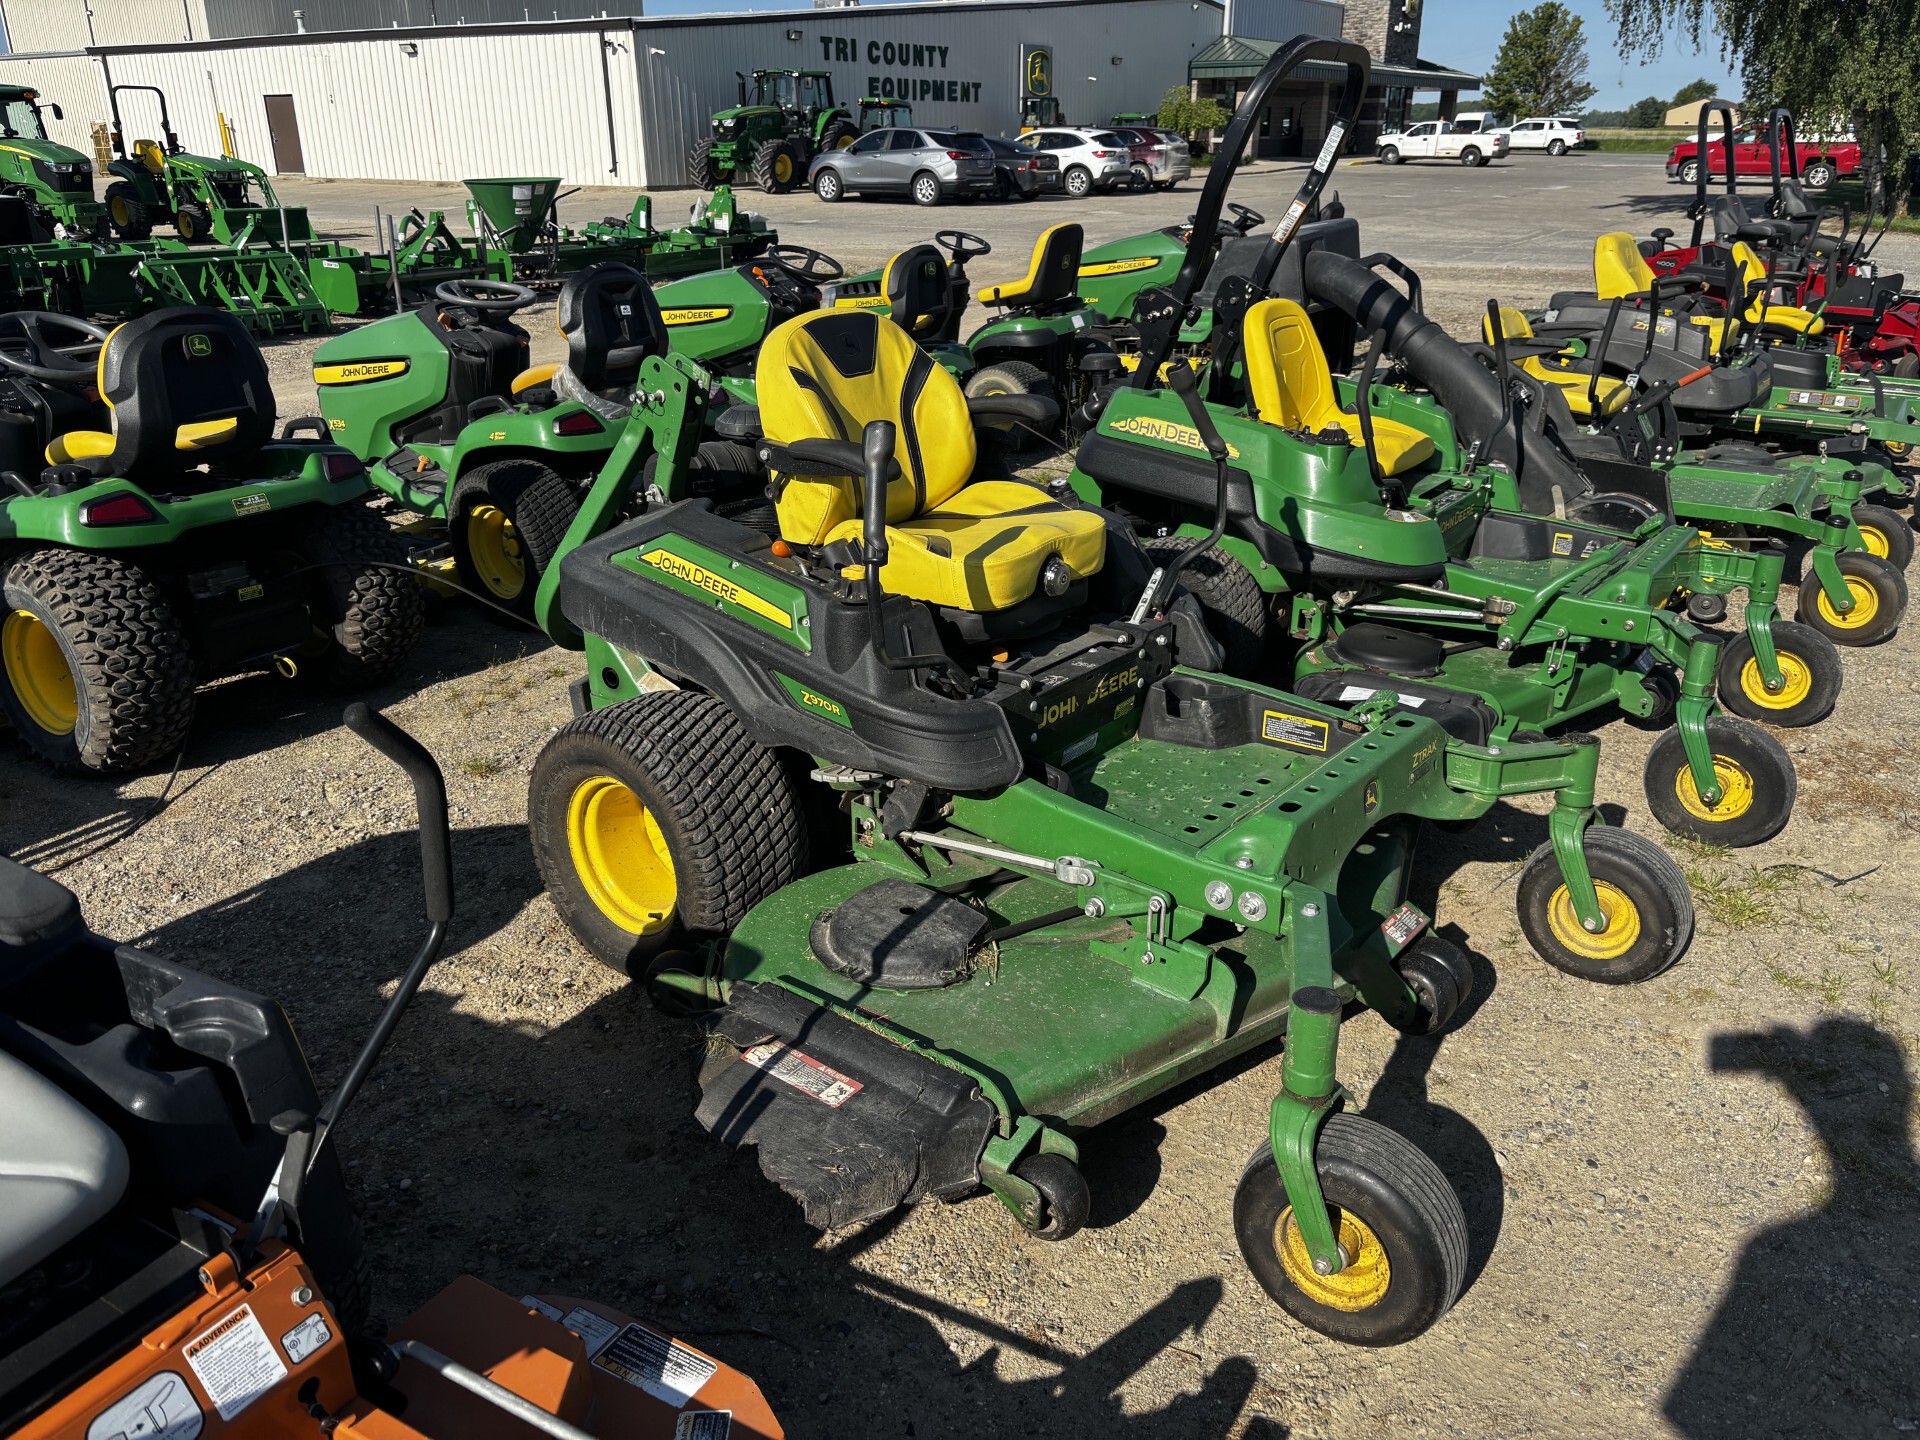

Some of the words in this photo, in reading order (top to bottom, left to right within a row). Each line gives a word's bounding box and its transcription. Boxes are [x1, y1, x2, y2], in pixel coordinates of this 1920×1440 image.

[820, 36, 857, 62] TRI
[867, 41, 949, 68] COUNTY
[868, 77, 981, 103] EQUIPMENT
[1124, 262, 1147, 270] DEERE
[855, 299, 873, 307] JOHN
[666, 311, 687, 321] JOHN
[687, 310, 715, 320] DEERE
[340, 366, 361, 378] JOHN
[361, 364, 390, 375] DEERE
[1119, 418, 1162, 438] JOHN
[1455, 504, 1475, 525] DEERE
[654, 553, 691, 579] JOHN
[693, 568, 739, 601] DEERE
[801, 690, 841, 716] Z970R
[199, 1309, 248, 1350] ADVERTENCIA
